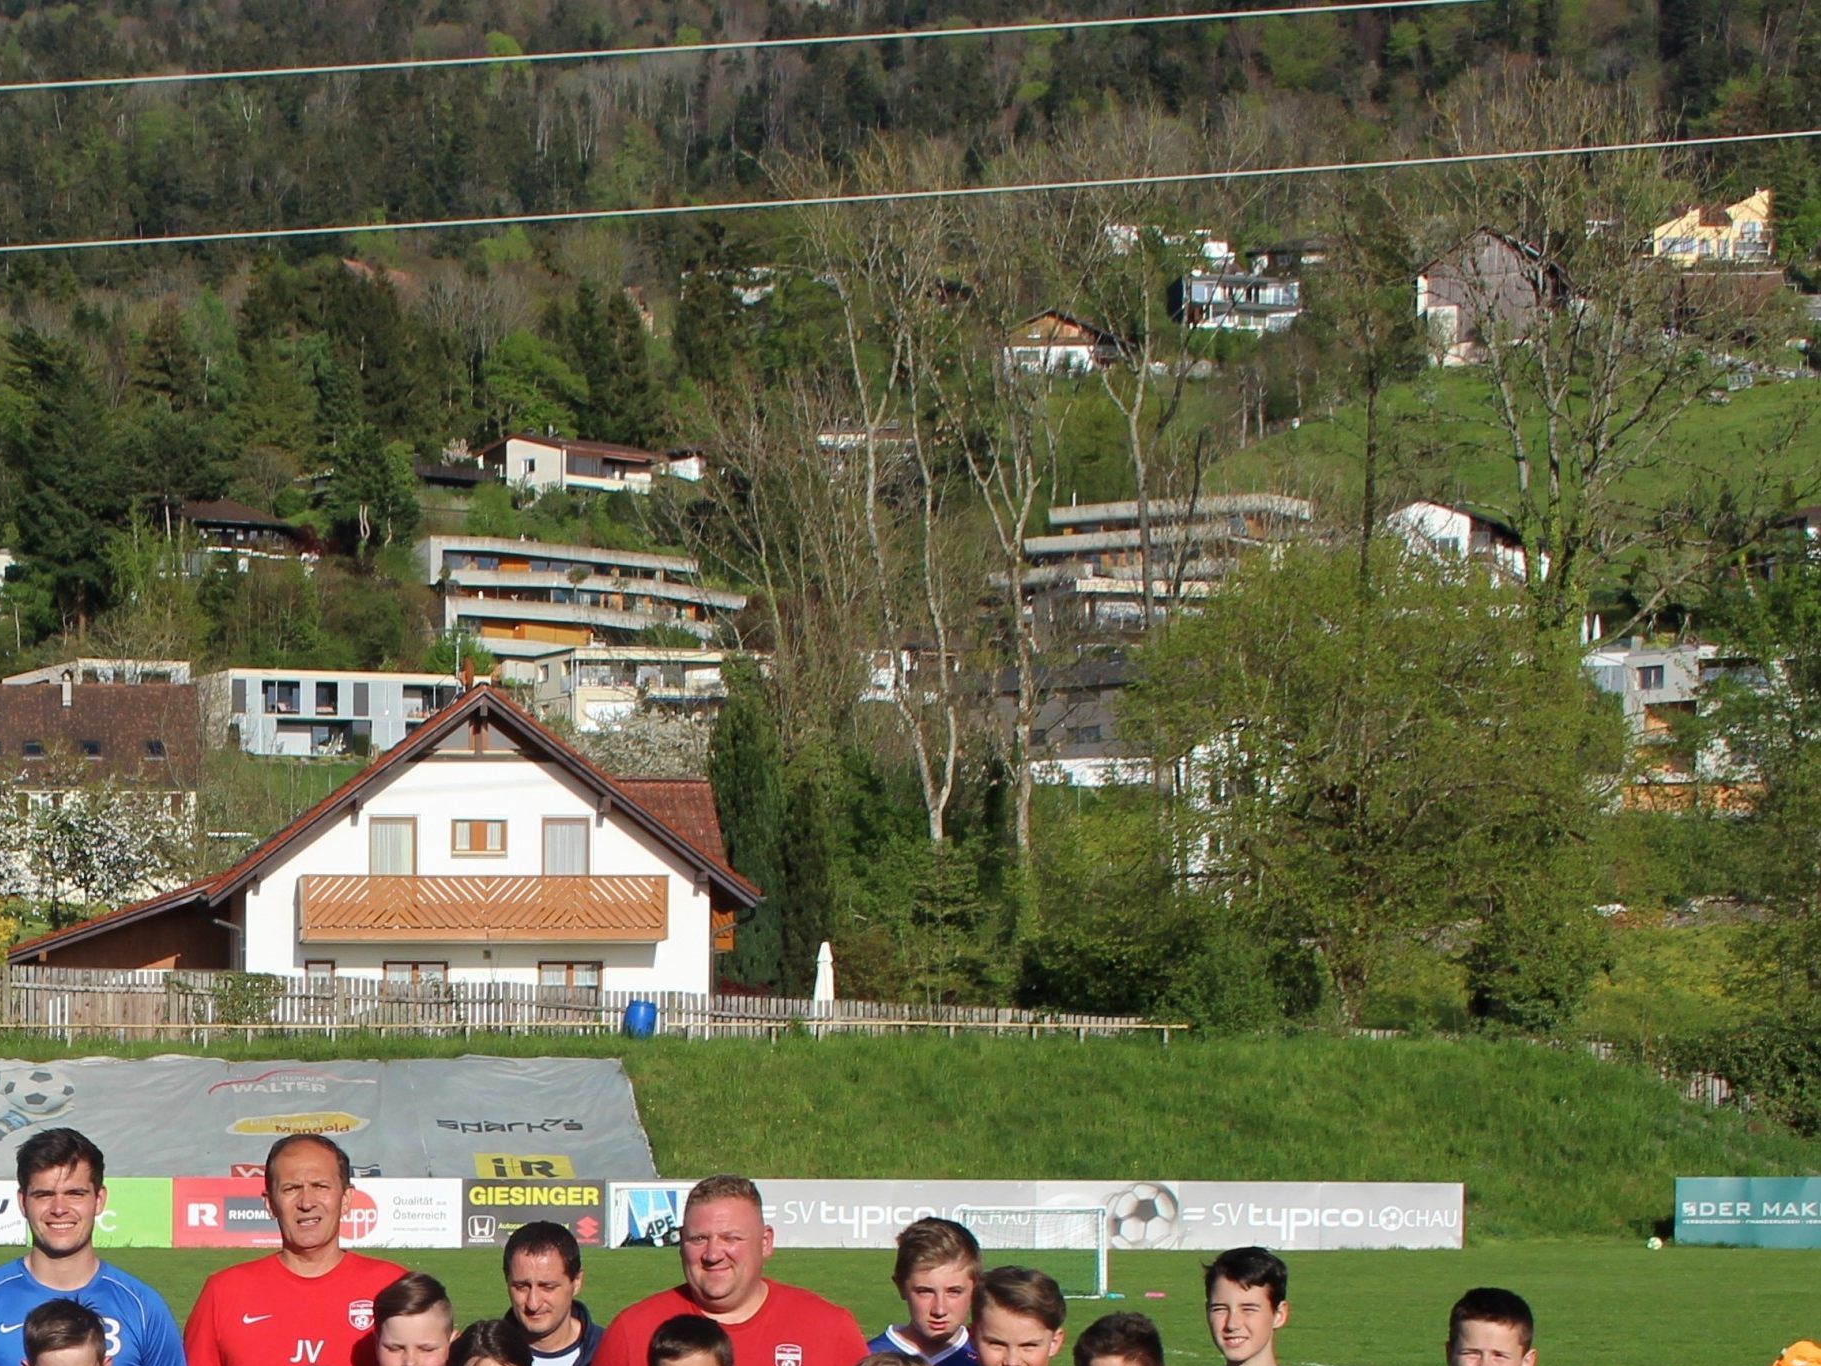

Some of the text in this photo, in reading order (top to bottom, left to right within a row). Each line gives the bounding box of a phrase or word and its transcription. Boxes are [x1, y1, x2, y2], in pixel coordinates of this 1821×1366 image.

[232, 1082, 327, 1093] WALTER
[275, 1124, 350, 1134] Mangold
[392, 1196, 433, 1207] Qualität
[469, 1186, 599, 1206] GIESINGER
[392, 1210, 447, 1221] Österreich
[784, 1200, 816, 1224] SV
[1700, 1202, 1821, 1216] DER MAK
[1212, 1203, 1244, 1226] SV
[1248, 1203, 1364, 1240] typico
[289, 1339, 325, 1364] JV
